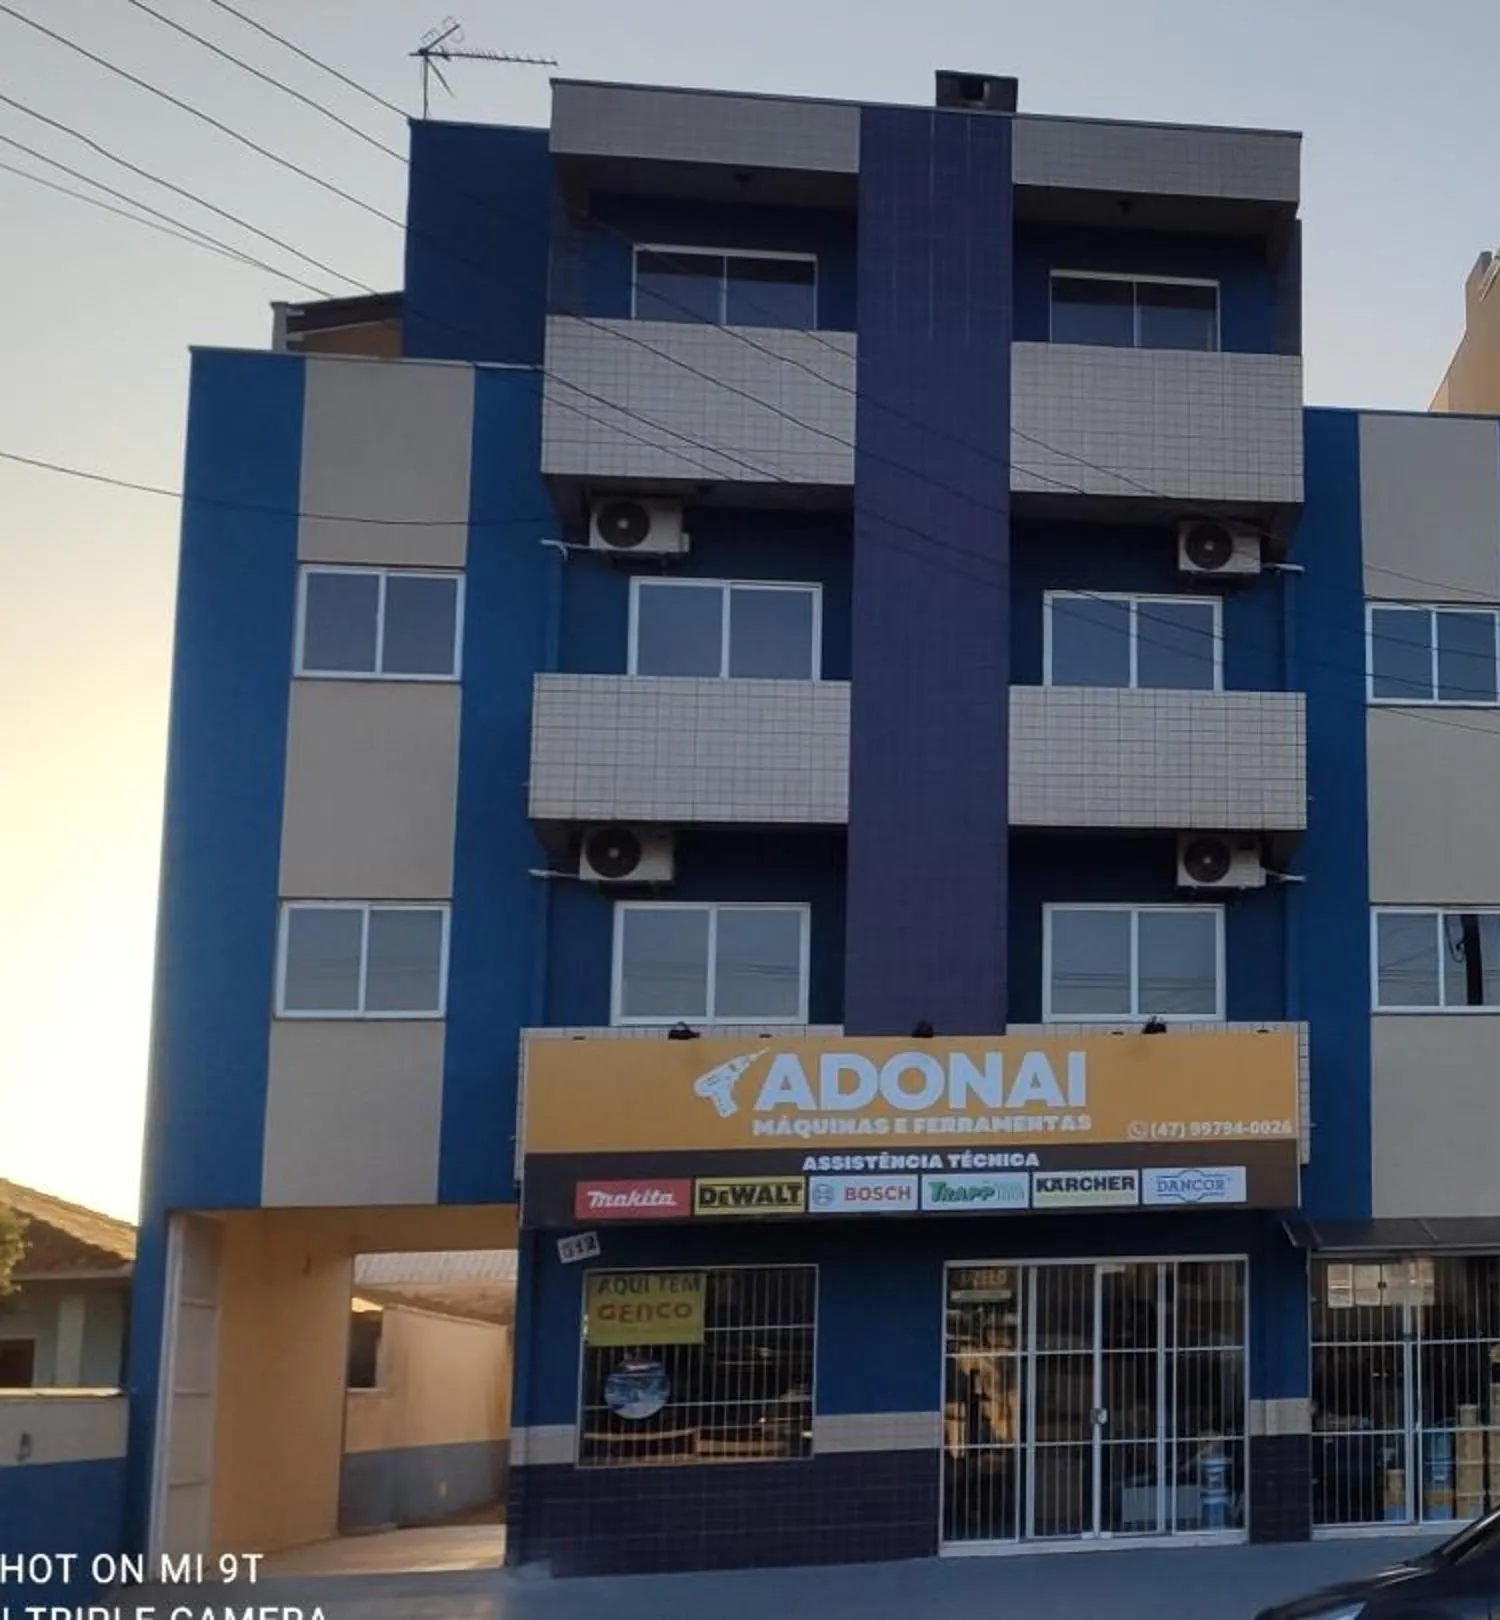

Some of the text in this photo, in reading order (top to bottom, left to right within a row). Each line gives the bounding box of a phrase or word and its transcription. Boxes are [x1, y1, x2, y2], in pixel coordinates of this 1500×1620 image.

[753, 1051, 1087, 1111] ADONAI
[753, 1114, 1092, 1139] MÁQUINAS E FERRAMENTAS
[1151, 1121, 1185, 1138] (47)
[802, 1150, 1040, 1171] ASSISTÊNCIA TÉCNICA
[844, 1186, 911, 1201] BOSCH
[1036, 1175, 1135, 1193] KÄRCHER
[1157, 1178, 1226, 1192] DANCOR
[598, 1274, 700, 1295] AQUI TEM
